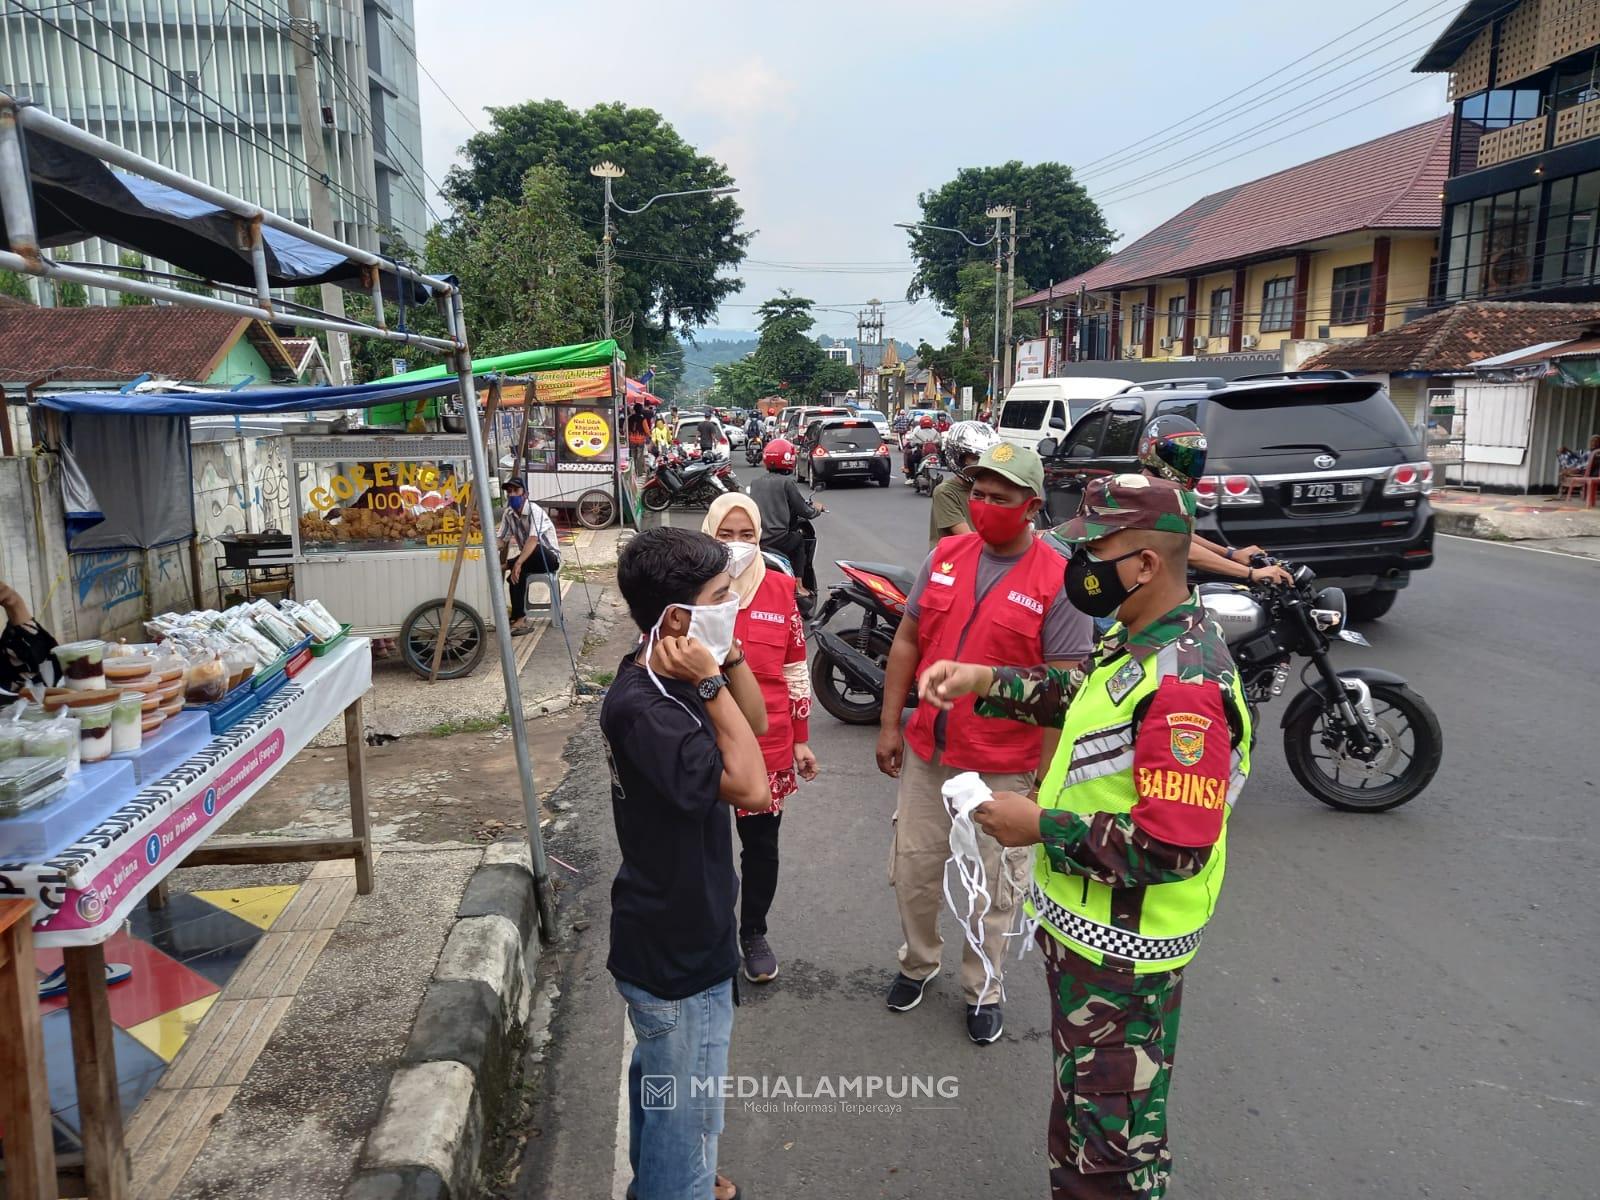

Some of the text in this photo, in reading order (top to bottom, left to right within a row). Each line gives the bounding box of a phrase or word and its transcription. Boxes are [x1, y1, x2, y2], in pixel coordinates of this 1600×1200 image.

[309, 462, 472, 511] GORENGAN
[368, 492, 416, 510] 1000
[1219, 615, 1252, 624] YAMAHA
[1139, 768, 1226, 810] BABINSA
[76, 789, 172, 849] SEJARAH
[162, 834, 174, 847] Eva
[175, 812, 197, 836] Dwiana
